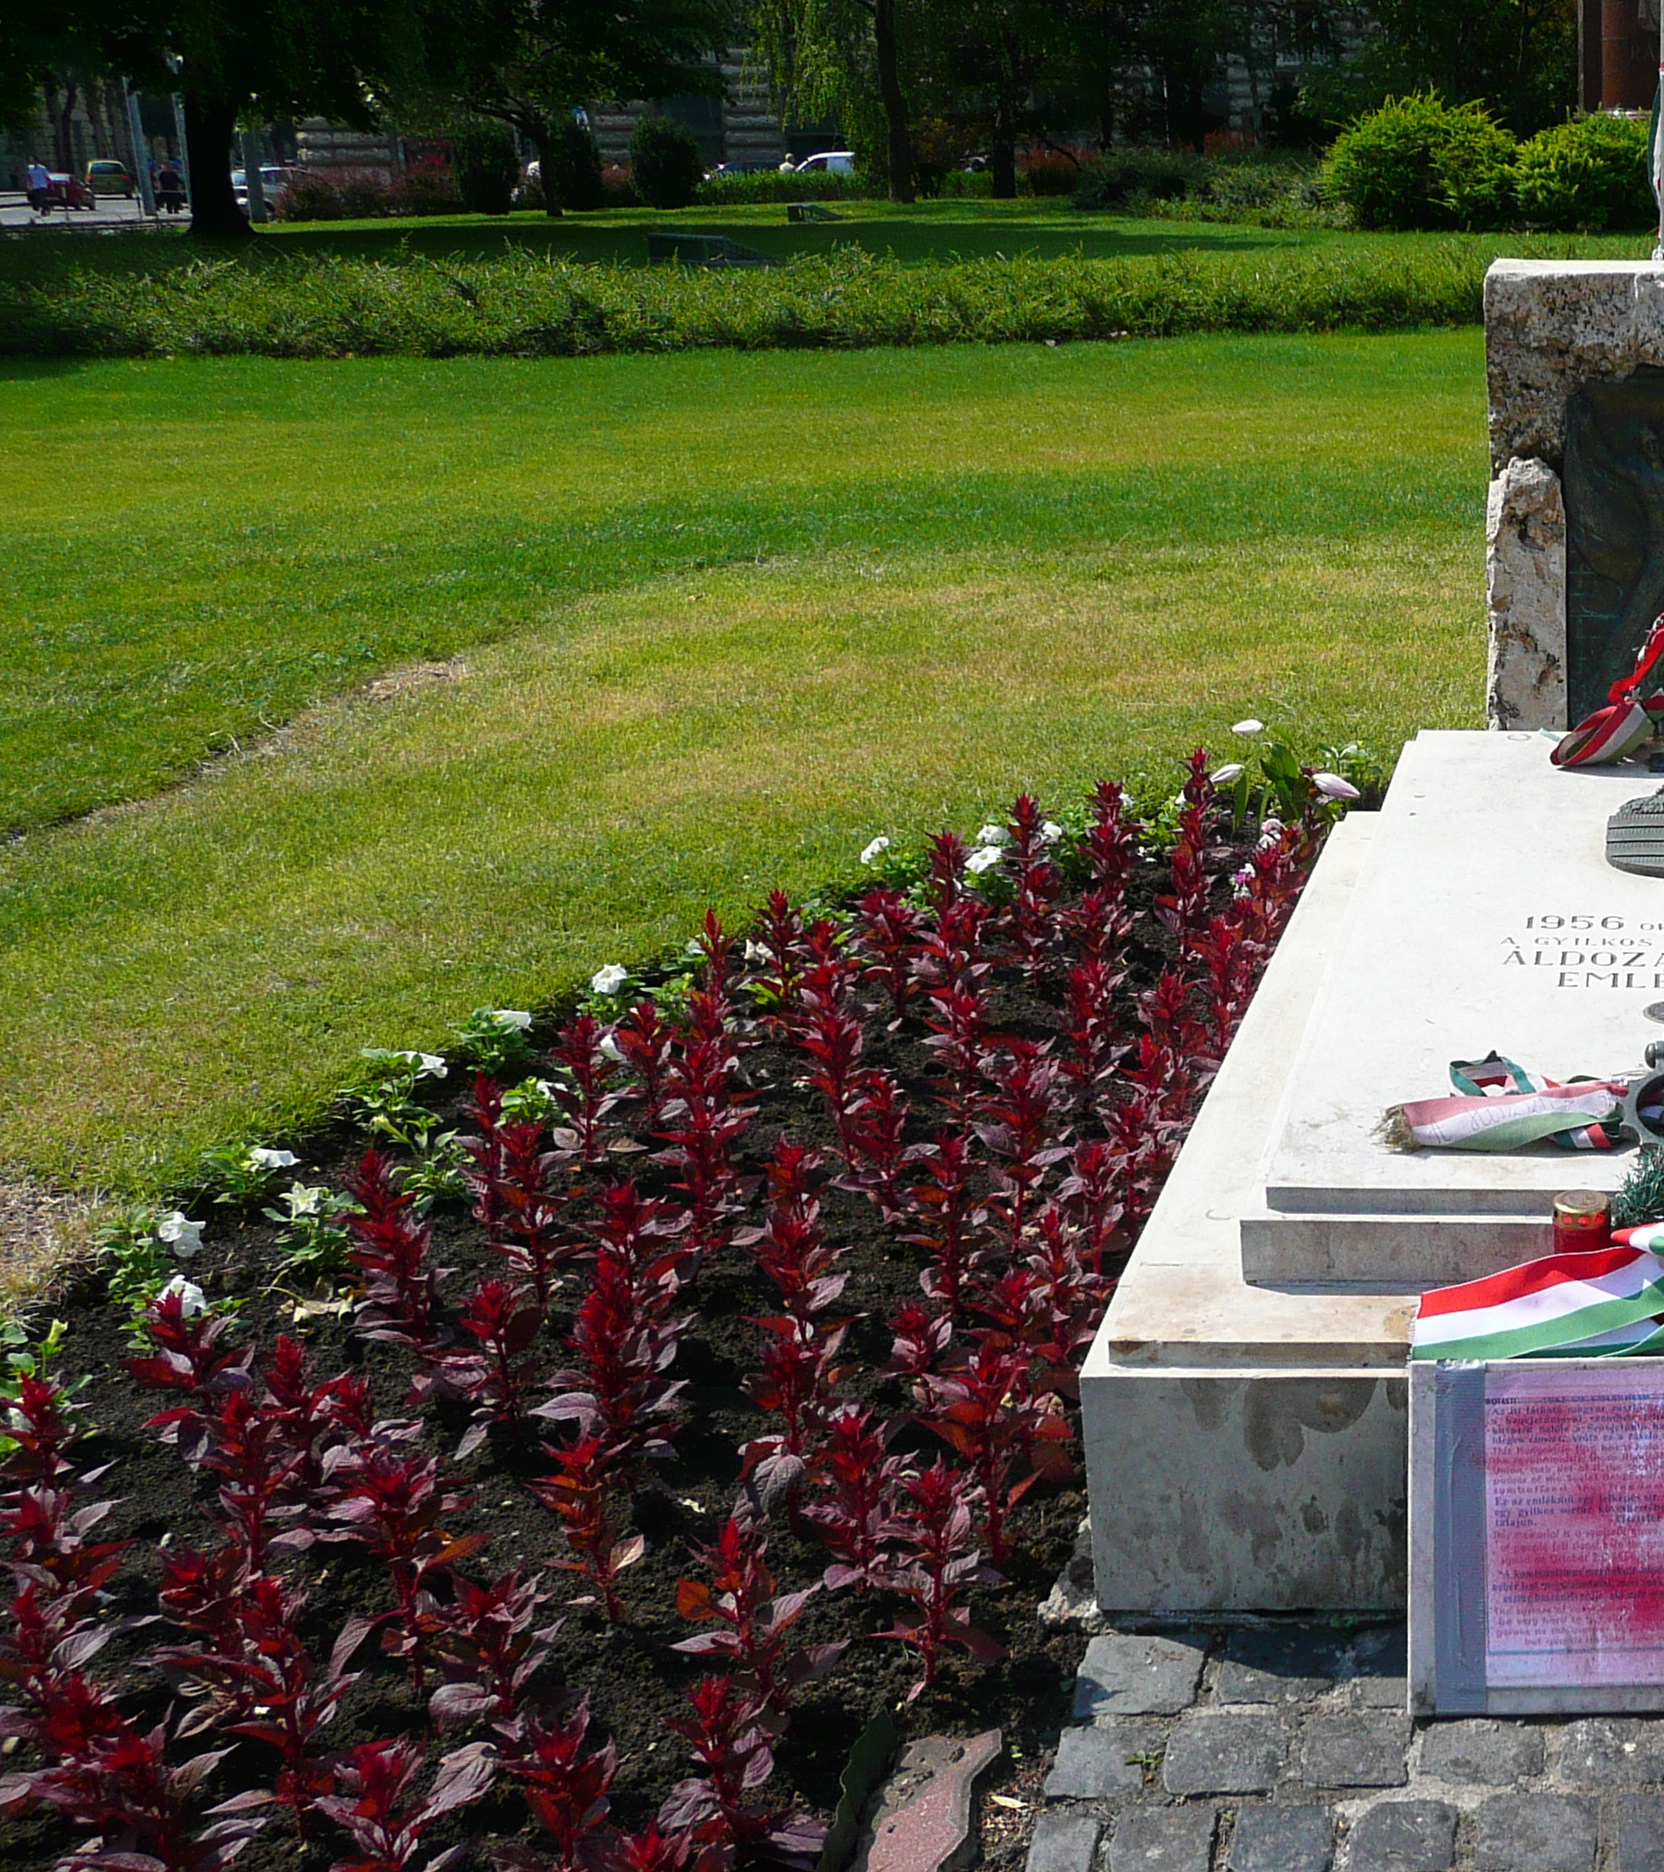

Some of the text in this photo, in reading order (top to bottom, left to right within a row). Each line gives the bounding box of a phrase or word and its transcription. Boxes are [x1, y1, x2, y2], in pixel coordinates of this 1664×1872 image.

[1525, 915, 1625, 930] 1956
[1500, 936, 1516, 945] A
[1534, 937, 1652, 946] GYILKOS
